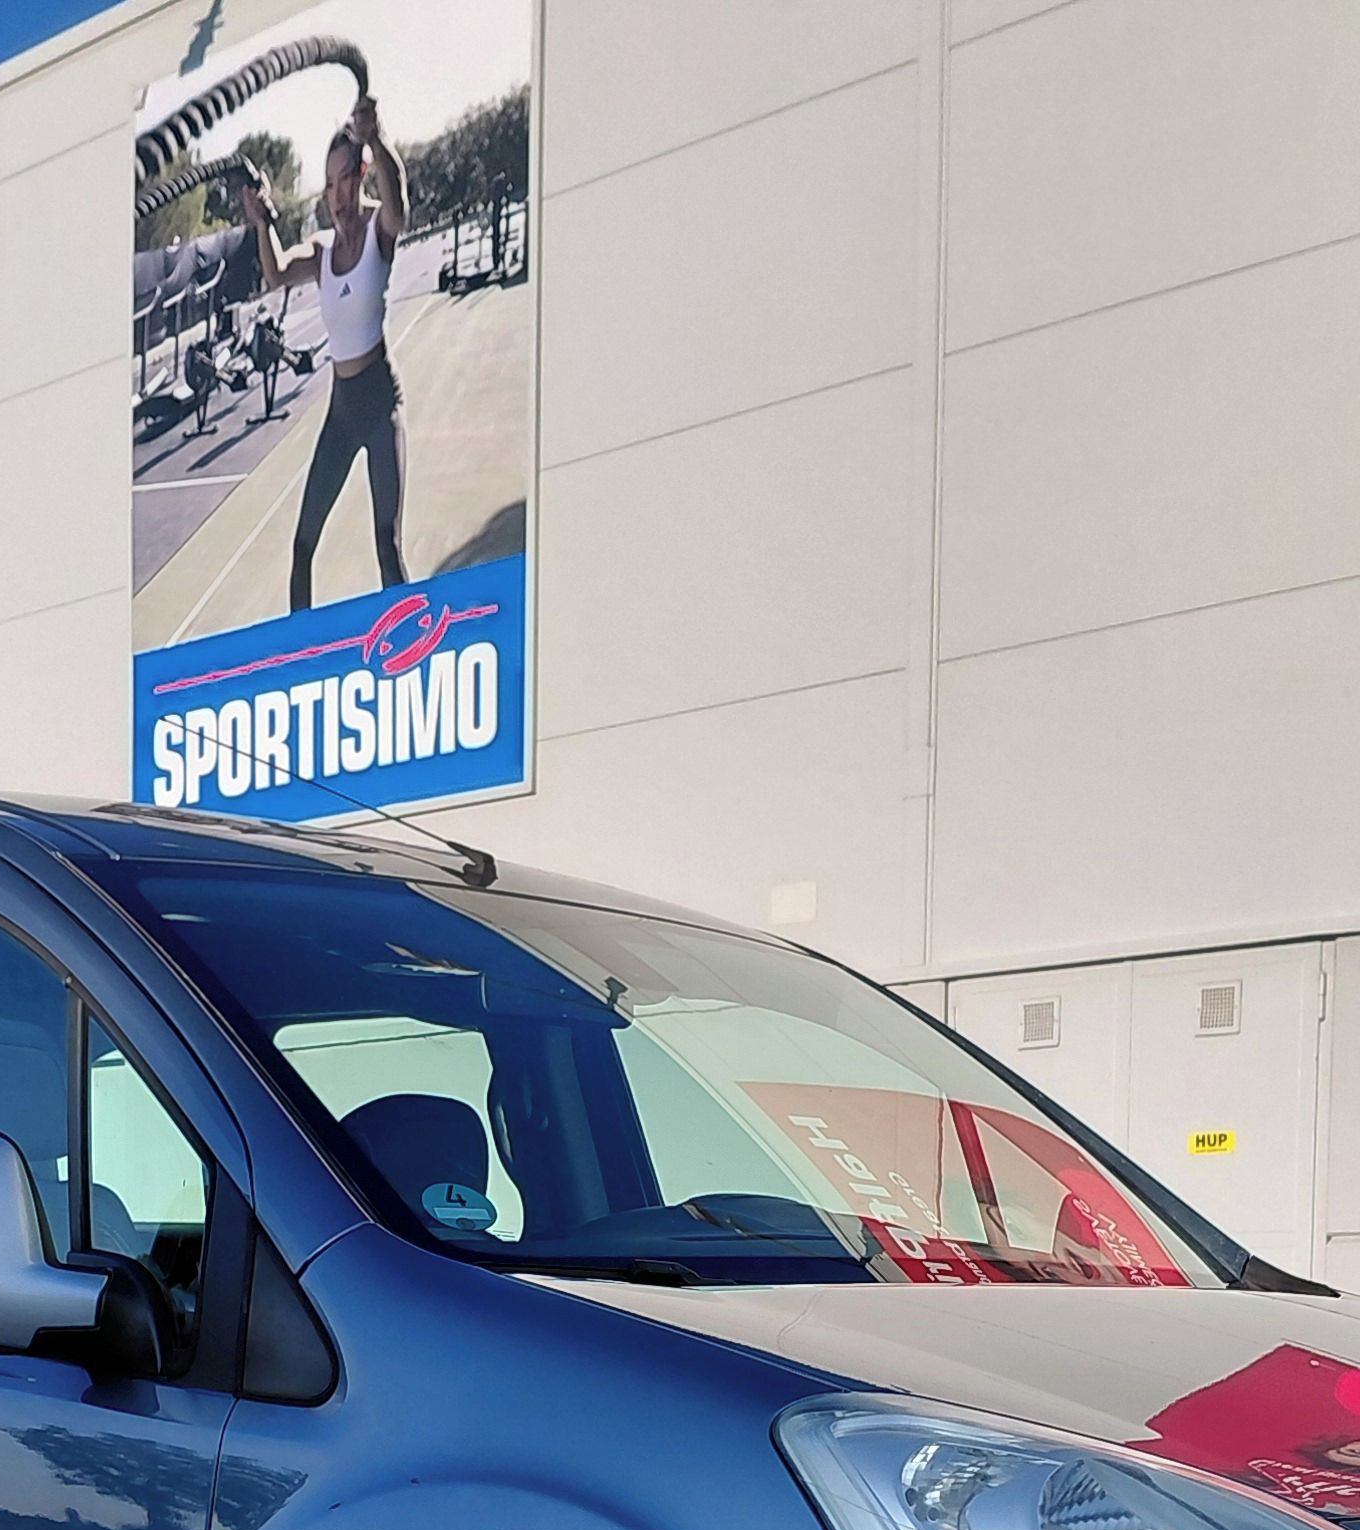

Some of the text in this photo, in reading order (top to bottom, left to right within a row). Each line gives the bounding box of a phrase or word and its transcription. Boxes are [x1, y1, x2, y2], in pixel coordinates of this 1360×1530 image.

[152, 641, 499, 809] SPORTISIMO
[1195, 1133, 1228, 1148] HUP
[445, 1184, 468, 1208] 4
